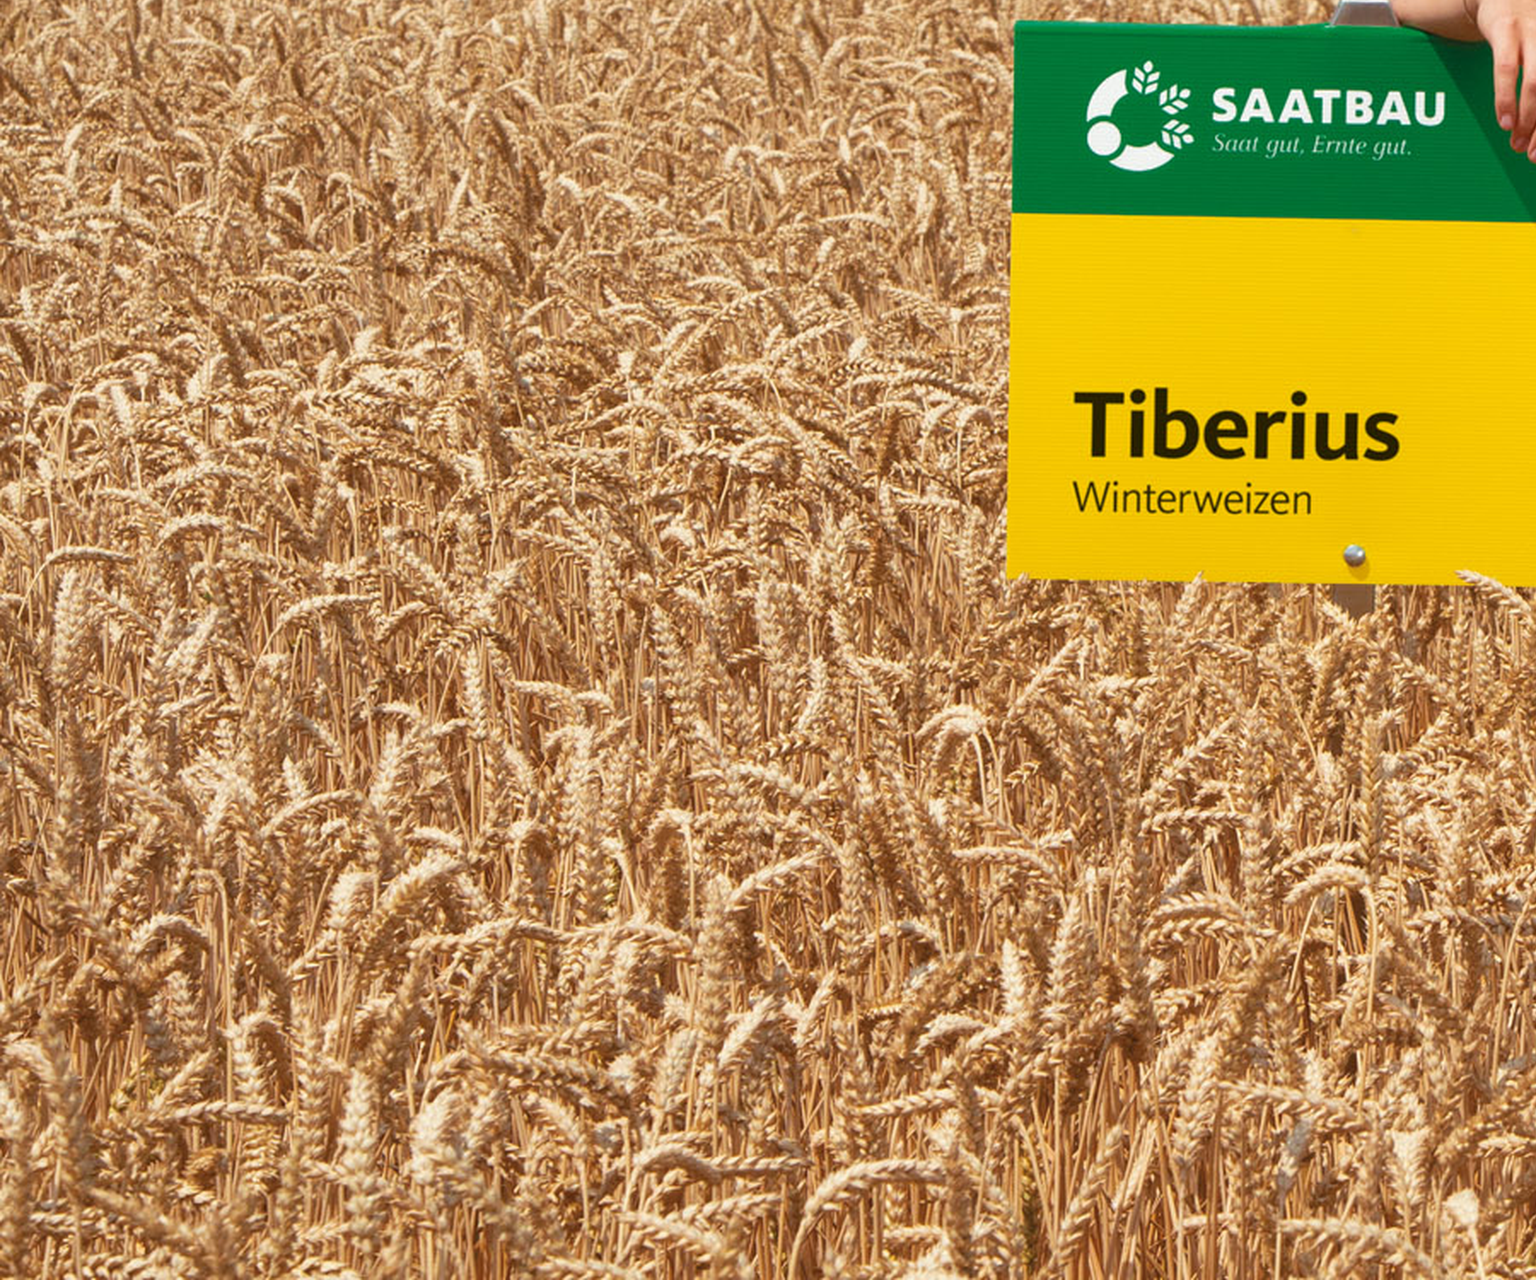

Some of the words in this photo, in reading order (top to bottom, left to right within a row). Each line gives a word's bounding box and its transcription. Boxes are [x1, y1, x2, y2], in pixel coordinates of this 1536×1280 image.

[1212, 87, 1446, 127] SAATBAU
[1212, 133, 1259, 153] Saat
[1312, 135, 1366, 156] Ernte
[1371, 138, 1412, 161] gut.
[1074, 387, 1401, 462] Tiberius
[1072, 480, 1312, 515] Winterweizen
